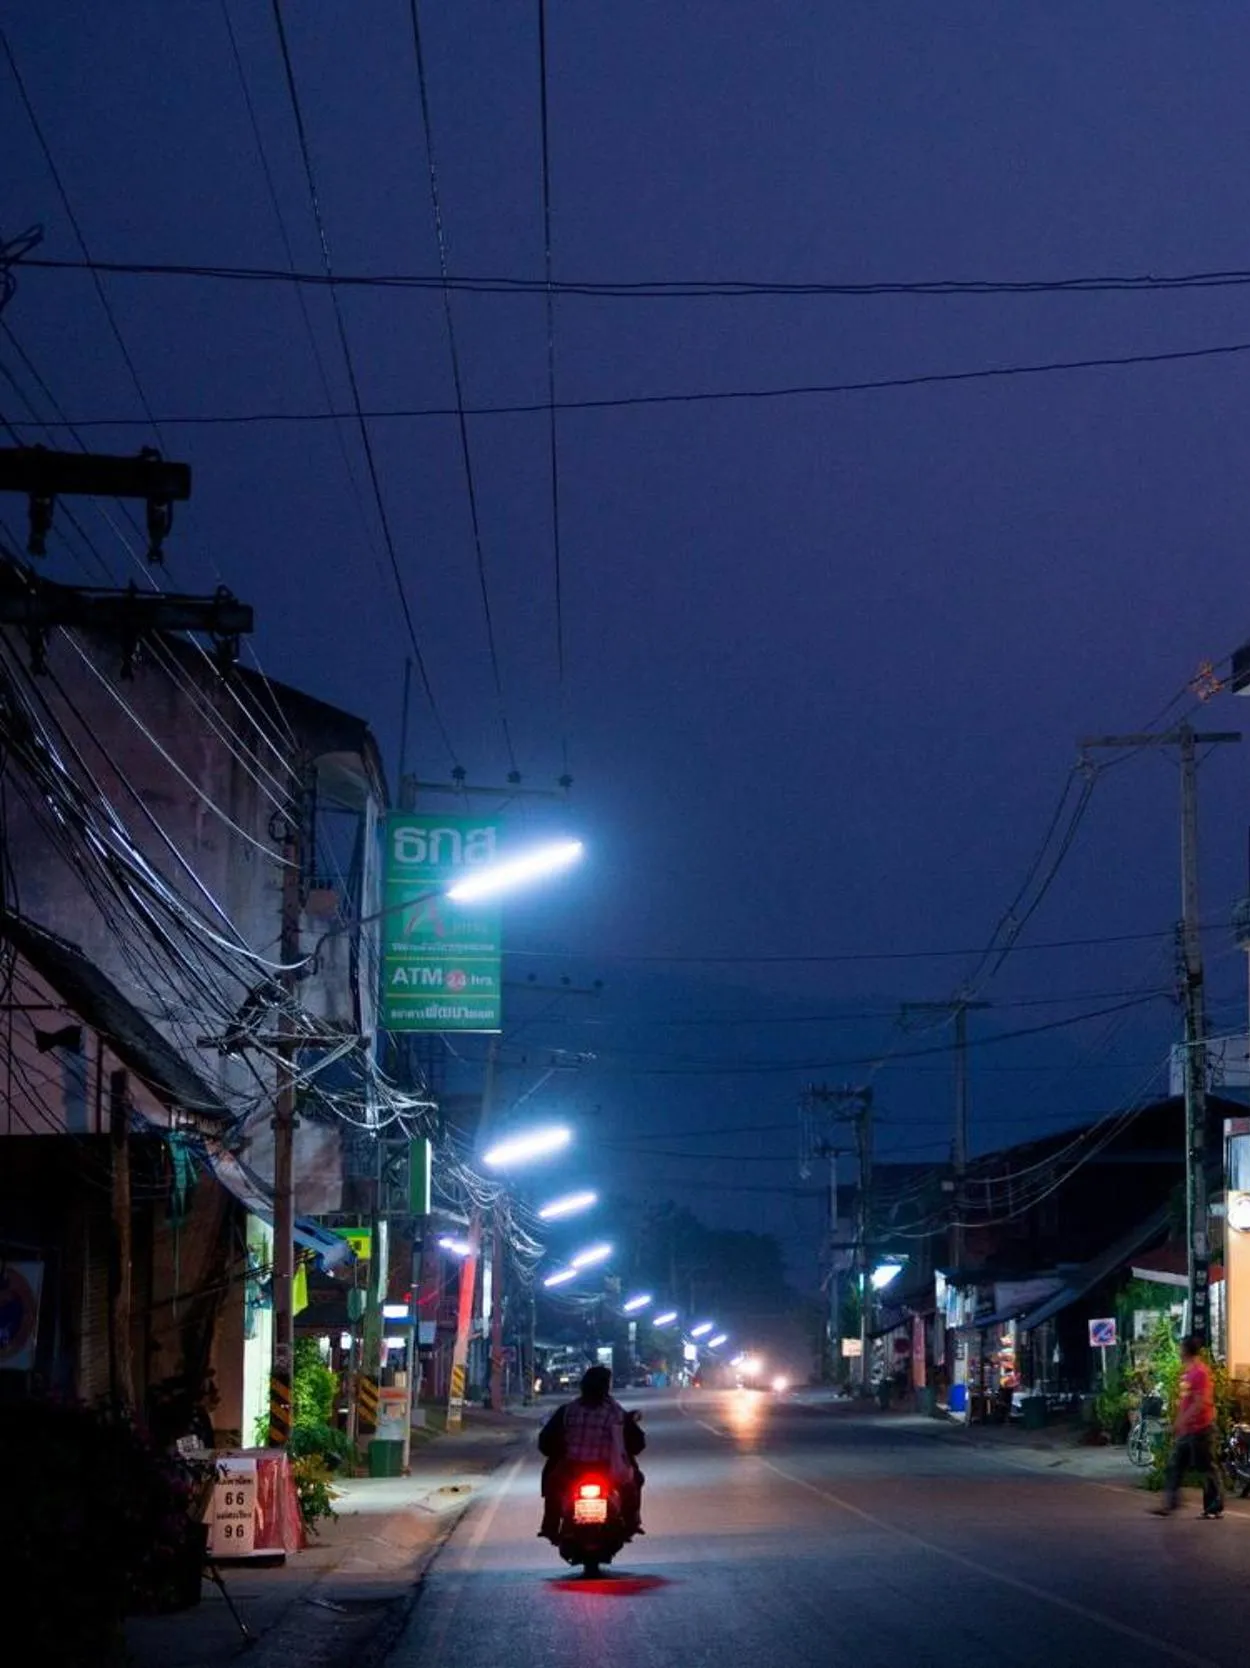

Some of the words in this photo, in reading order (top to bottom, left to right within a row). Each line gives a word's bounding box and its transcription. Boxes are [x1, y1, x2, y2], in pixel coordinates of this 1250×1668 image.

[392, 967, 442, 985] ATM
[225, 1492, 245, 1506] 66
[225, 1524, 245, 1538] 96
